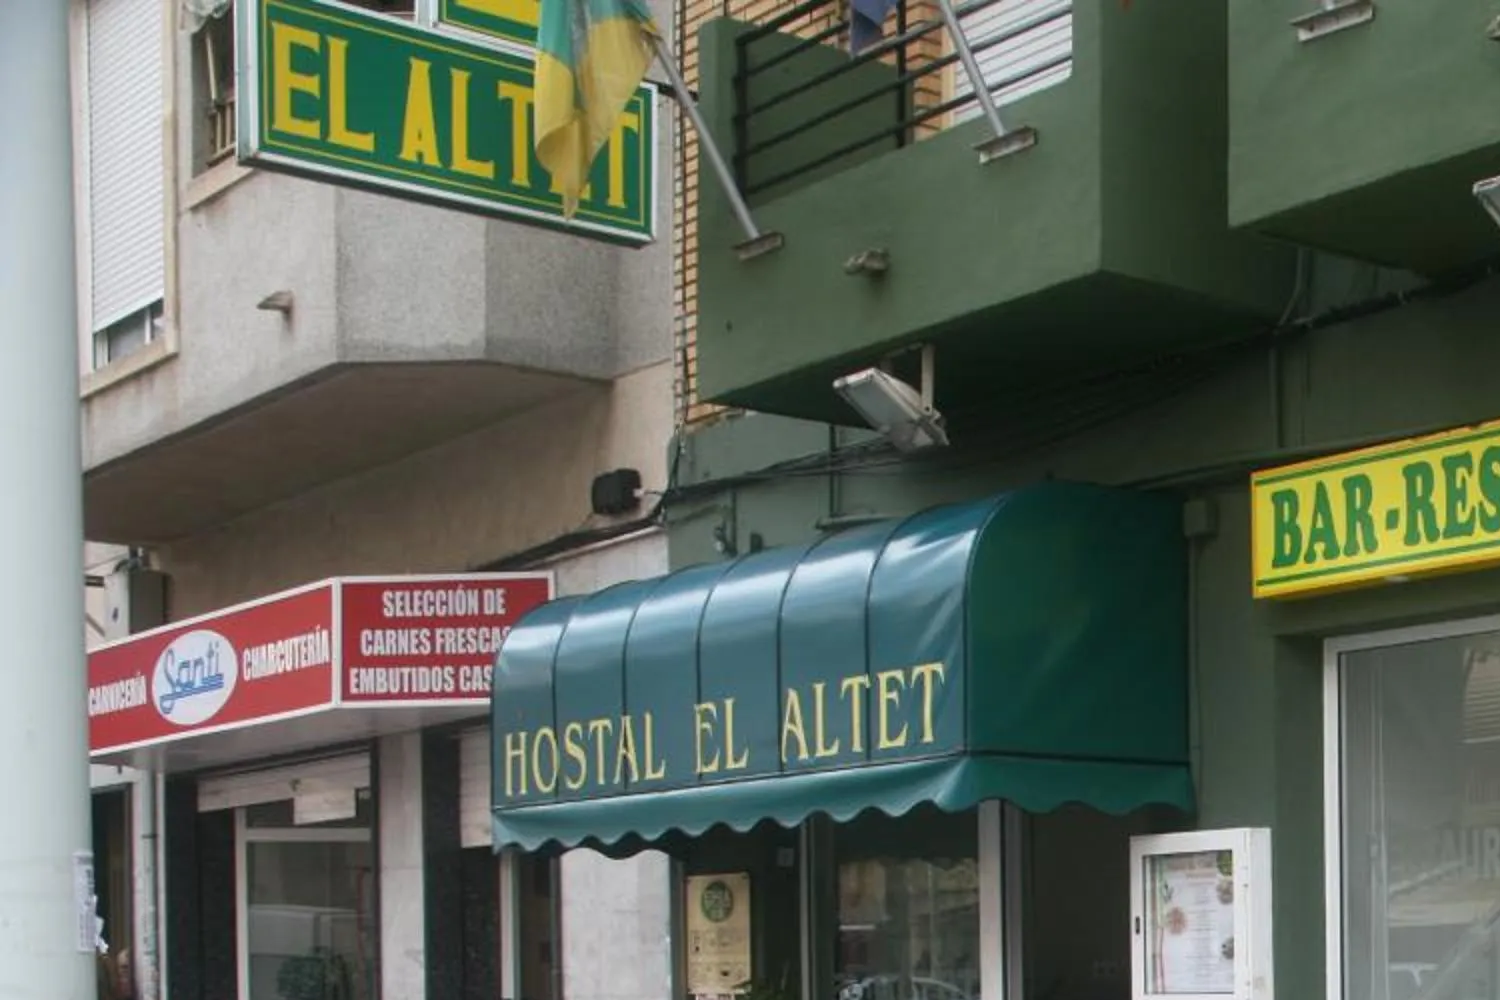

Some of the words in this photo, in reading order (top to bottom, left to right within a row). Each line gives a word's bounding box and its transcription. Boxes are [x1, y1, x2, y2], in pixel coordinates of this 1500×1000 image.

[271, 21, 375, 154] EL
[398, 56, 640, 208] ALTT
[382, 584, 479, 617] SELECCIÓN
[483, 587, 507, 616] DE
[242, 624, 330, 681] CHARCUTERÍA
[360, 628, 431, 656] CARNES
[160, 640, 224, 714] Santi
[350, 665, 455, 695] EMBUTIDOS
[504, 711, 666, 797] HOSTAL
[693, 697, 750, 775] EL
[780, 661, 946, 764] ALTET
